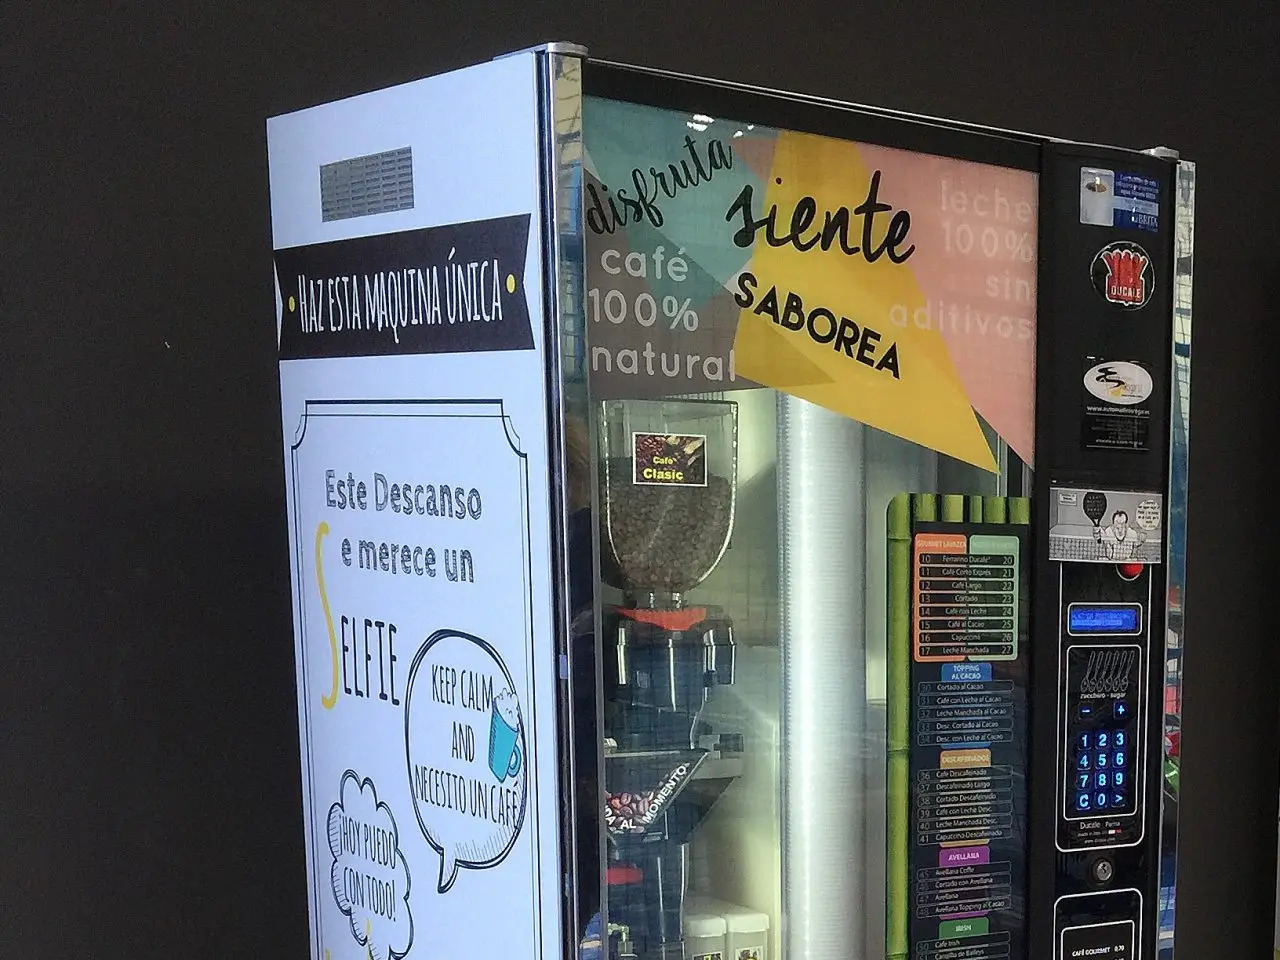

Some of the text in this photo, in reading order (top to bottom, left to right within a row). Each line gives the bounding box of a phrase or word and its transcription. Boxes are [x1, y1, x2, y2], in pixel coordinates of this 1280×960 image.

[587, 134, 732, 236] disfruta
[940, 180, 1031, 221] leche
[725, 170, 915, 264] siente
[601, 247, 689, 282] café
[941, 225, 1033, 262] 100%
[298, 247, 503, 343] HAZ ESTA MAQUINA ÚNICA
[987, 274, 1031, 300] sin
[588, 288, 699, 332] 100%
[735, 272, 901, 379] SABOREA
[890, 302, 1033, 339] aditivos
[592, 343, 736, 381] natural
[325, 469, 482, 520] Este Descanso
[643, 468, 684, 480] Clasic
[359, 540, 436, 577] merece
[445, 548, 474, 583] un
[432, 664, 493, 712] KEEP CALM
[452, 722, 475, 762] AND
[1080, 753, 1124, 767] 4 5 6
[1082, 733, 1124, 747] 1 2 3
[415, 764, 519, 827] NECESITO UN CAFÉ
[620, 765, 688, 830] AL MOMENTO
[1080, 773, 1123, 788] 7 8 9
[1080, 793, 1106, 808] C 0
[364, 824, 396, 870] PUEDO
[344, 867, 396, 922] CON TODO!
